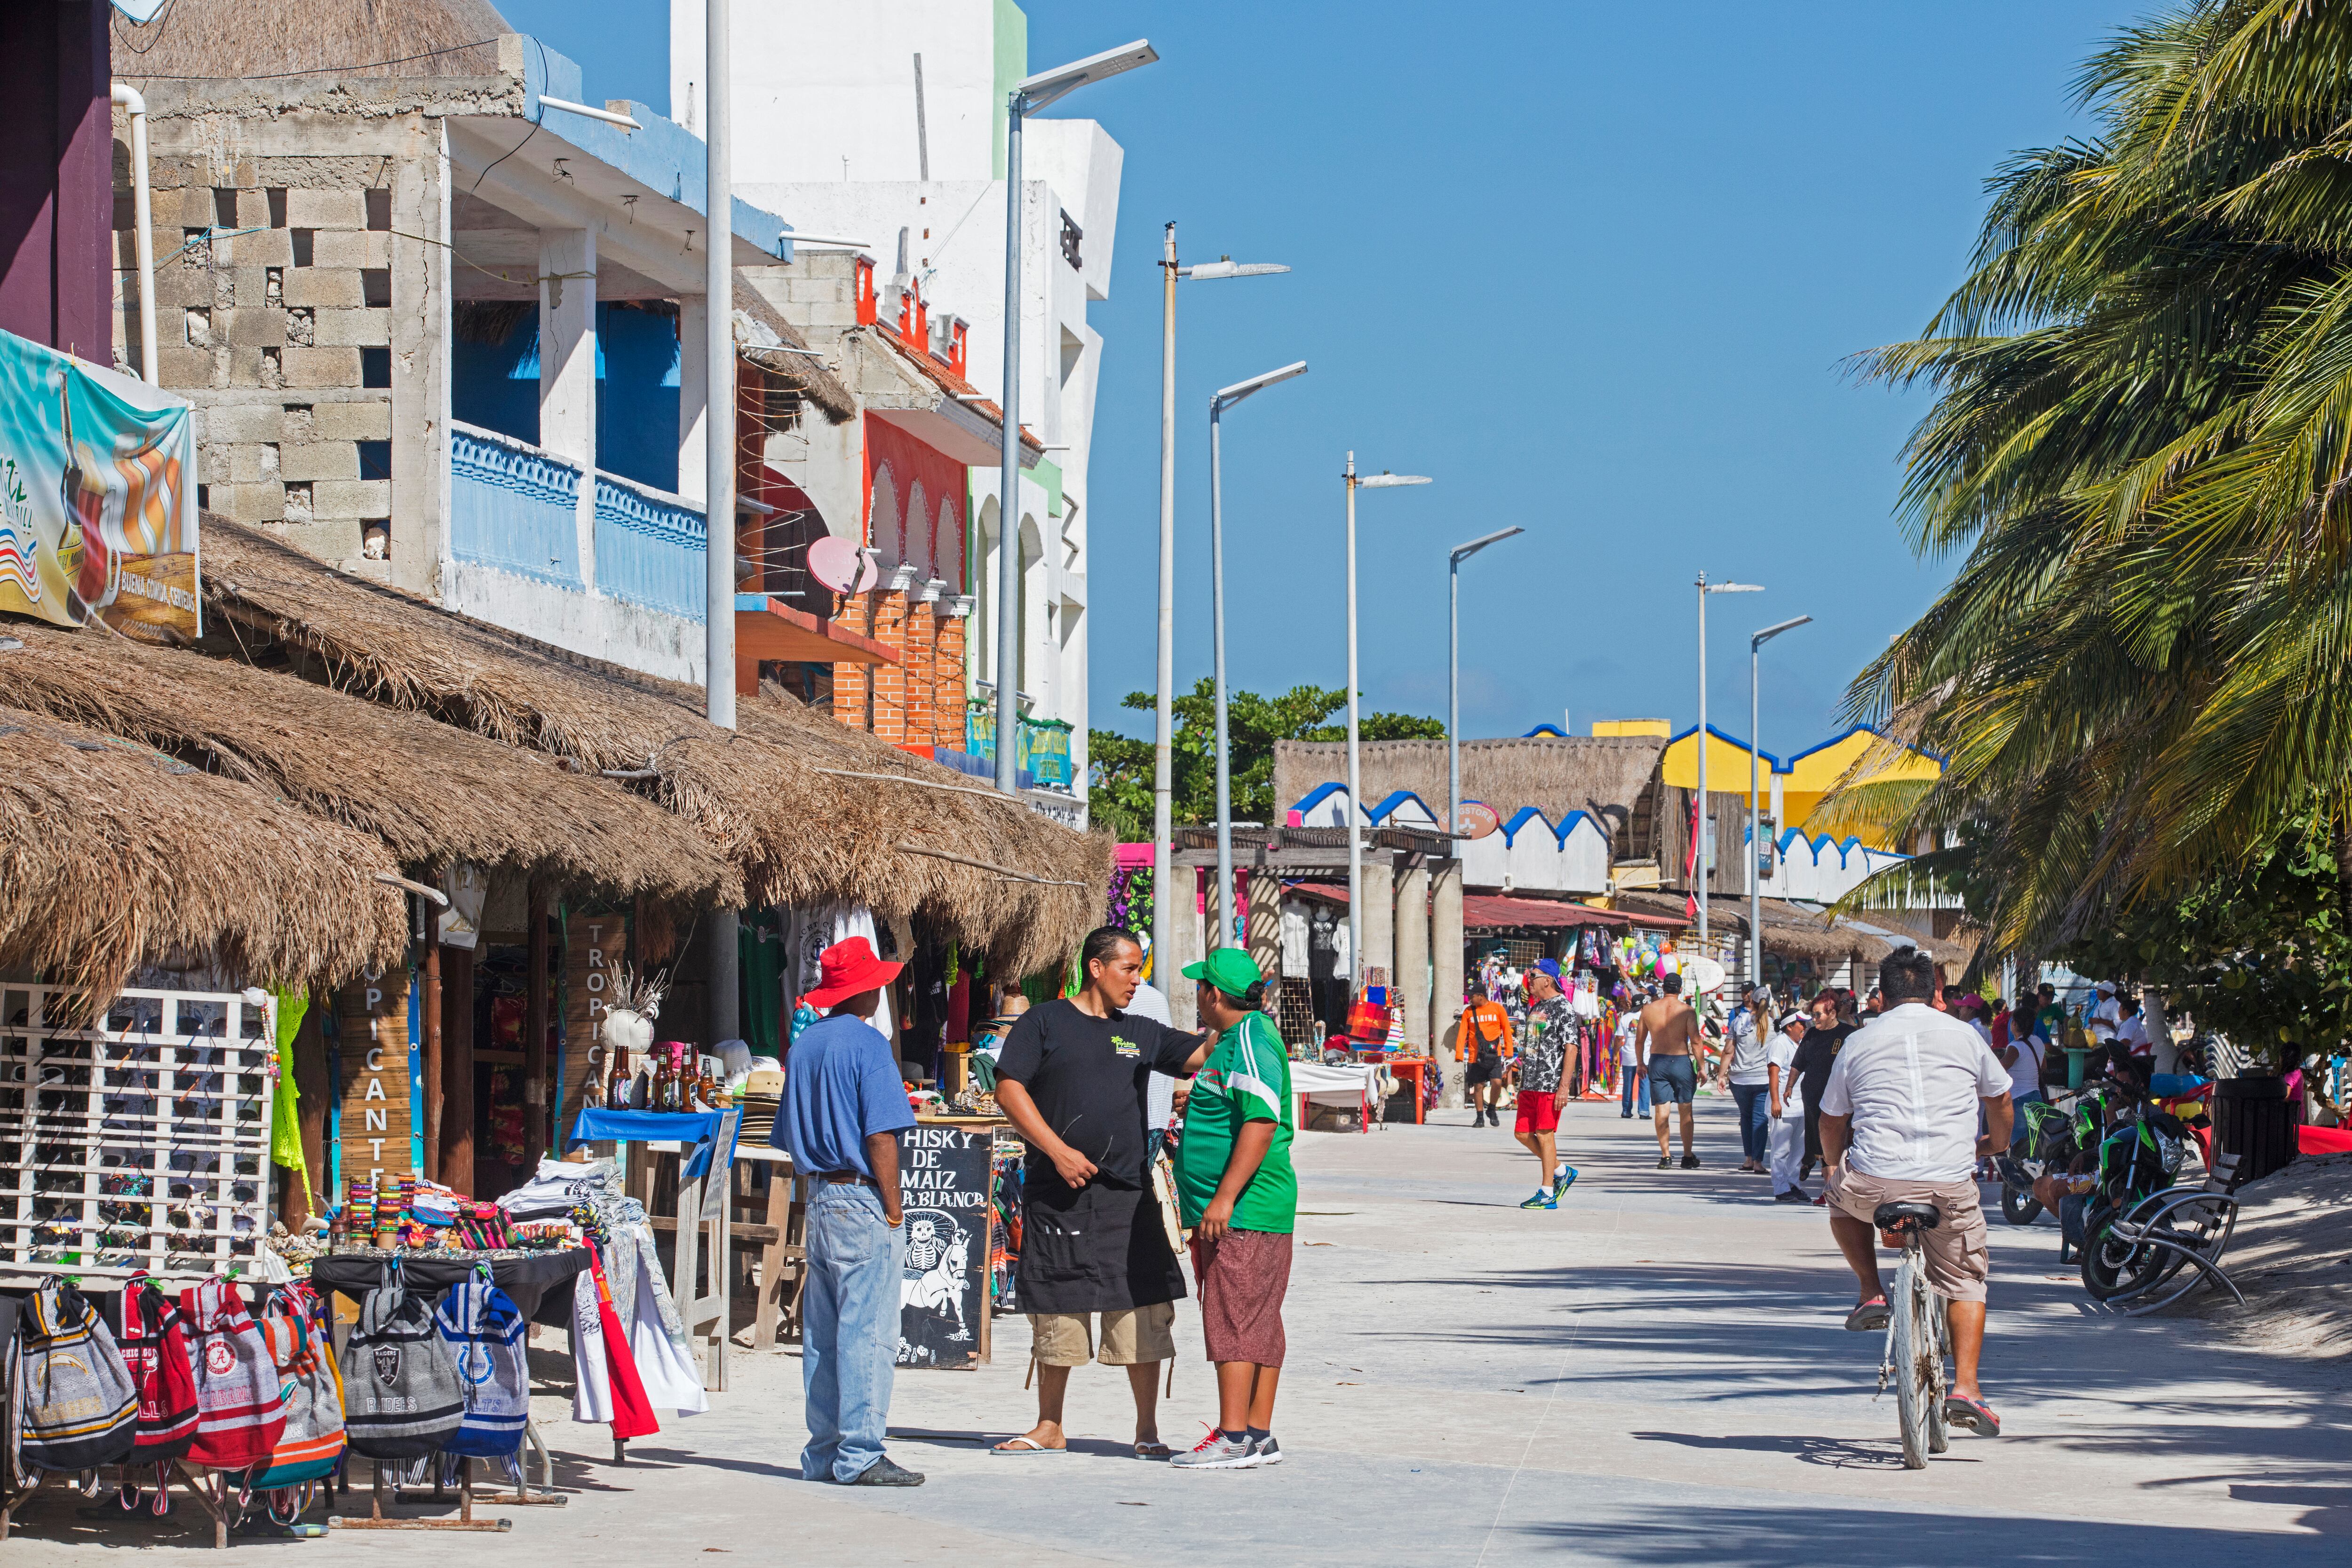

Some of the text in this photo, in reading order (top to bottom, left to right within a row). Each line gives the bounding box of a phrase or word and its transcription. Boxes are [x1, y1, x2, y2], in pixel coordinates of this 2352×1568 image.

[122, 570, 195, 613] BUENA COMIDA, CERVEZAS
[1441, 807, 1494, 824] DGSTORE
[799, 921, 818, 941] ACHT
[802, 977, 818, 989] Costa
[583, 925, 604, 1161] TROPICANE
[363, 960, 387, 1191] OPICANTE
[903, 1129, 974, 1149] HISKY
[911, 1149, 942, 1168] DE
[899, 1169, 956, 1189] MAIZ
[901, 1190, 988, 1208] A BLANCA
[122, 1348, 152, 1358] CHICGO
[198, 1385, 255, 1408] ALABAMA
[366, 1396, 417, 1412] RIDERS
[464, 1398, 501, 1413] OLTS
[138, 1400, 168, 1417] LLS
